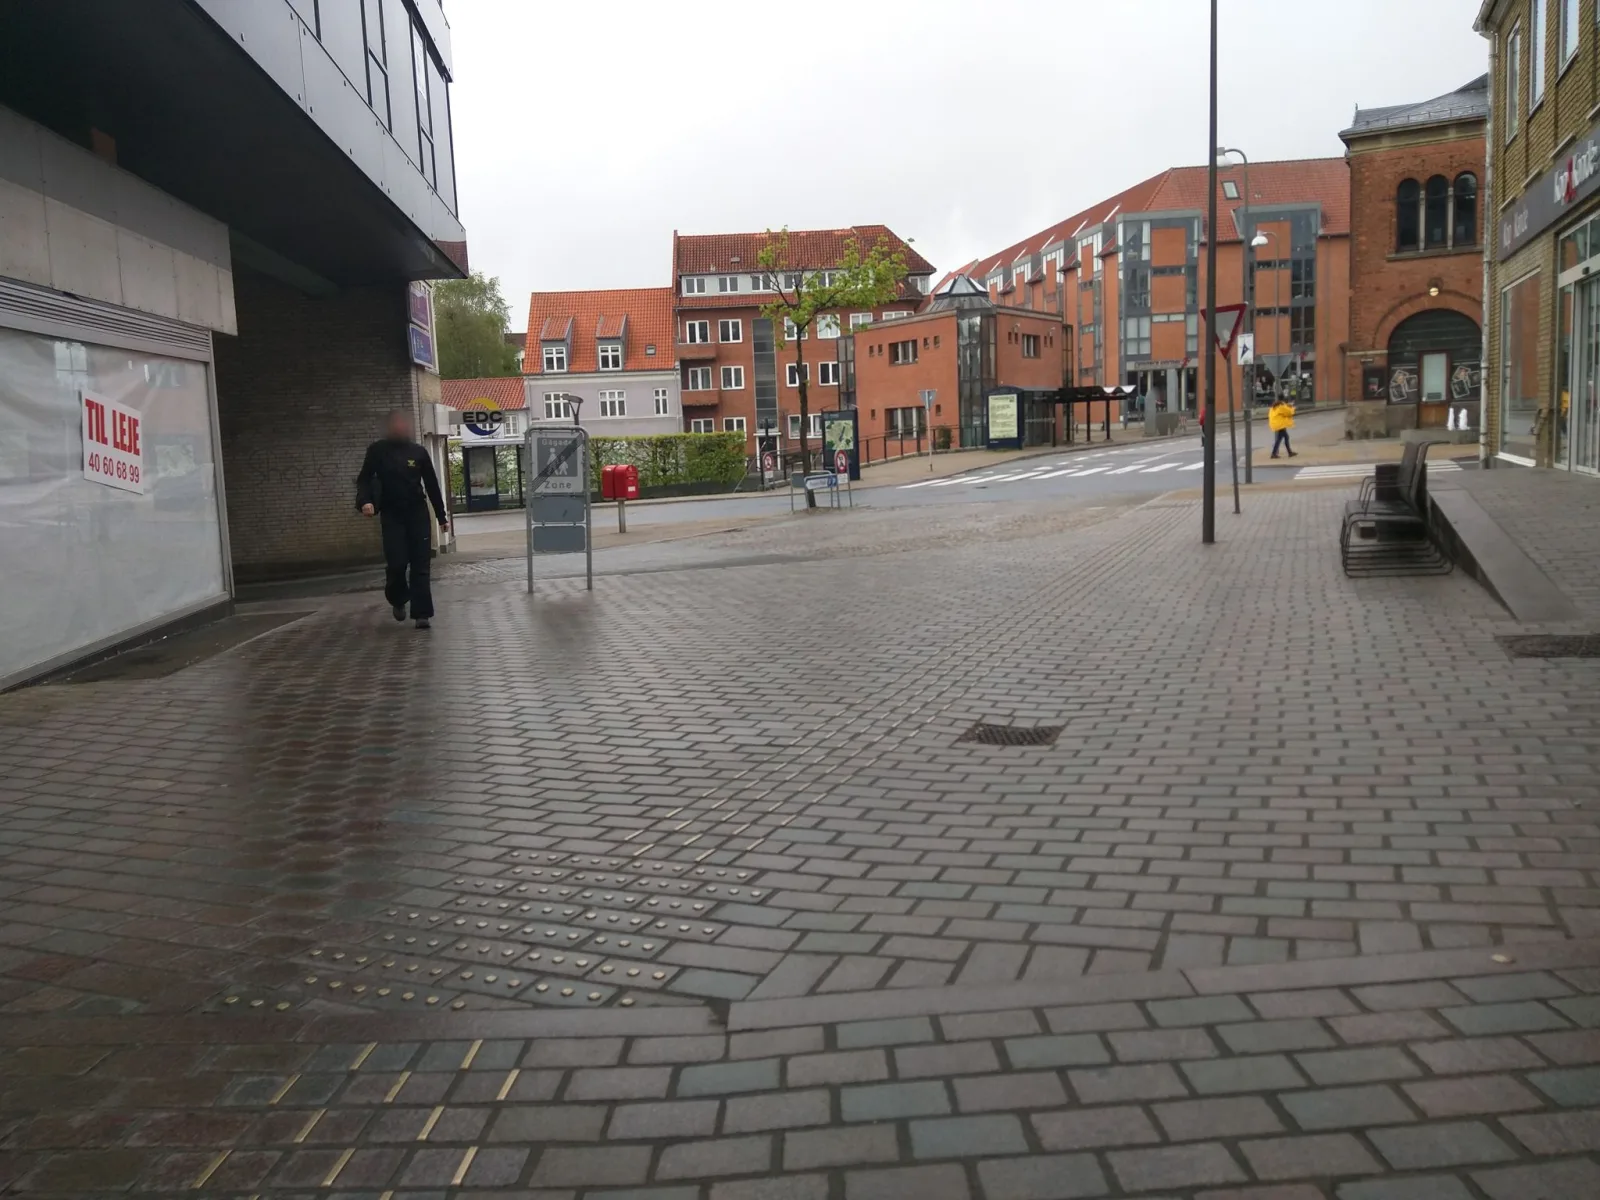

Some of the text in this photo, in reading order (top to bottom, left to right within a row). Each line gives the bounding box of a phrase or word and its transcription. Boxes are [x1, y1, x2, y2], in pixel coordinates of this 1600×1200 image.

[85, 398, 140, 456] TIL LEJE
[462, 411, 503, 423] EDC
[88, 452, 140, 484] 40 60 68 99
[543, 481, 573, 490] Zone
